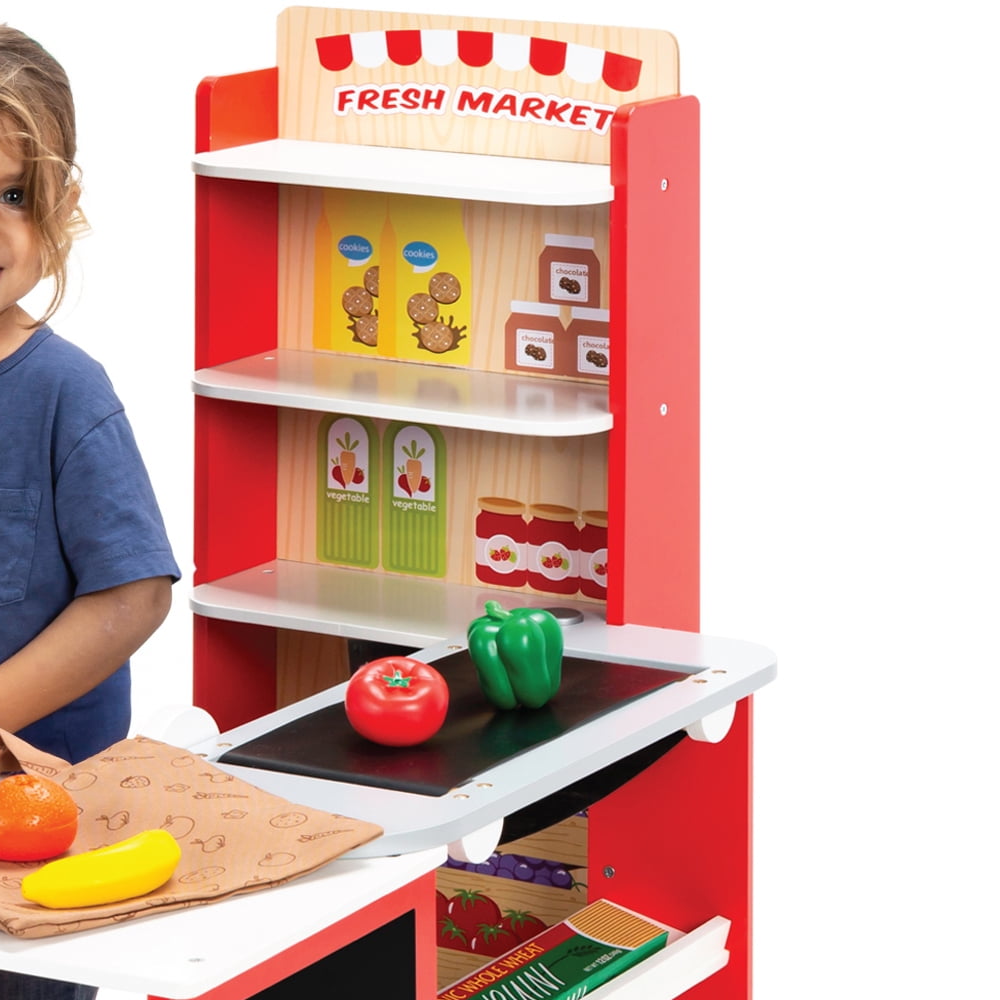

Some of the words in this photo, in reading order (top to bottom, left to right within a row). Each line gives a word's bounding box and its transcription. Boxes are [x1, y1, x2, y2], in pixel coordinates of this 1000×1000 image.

[338, 88, 446, 112] FRESH
[457, 90, 614, 131] MARKET
[339, 243, 370, 253] cookies
[403, 249, 436, 259] cookies
[326, 491, 370, 504] vegetable
[392, 500, 437, 513] vegetable
[458, 965, 508, 993] WHOLE
[503, 942, 545, 969] WHEAT
